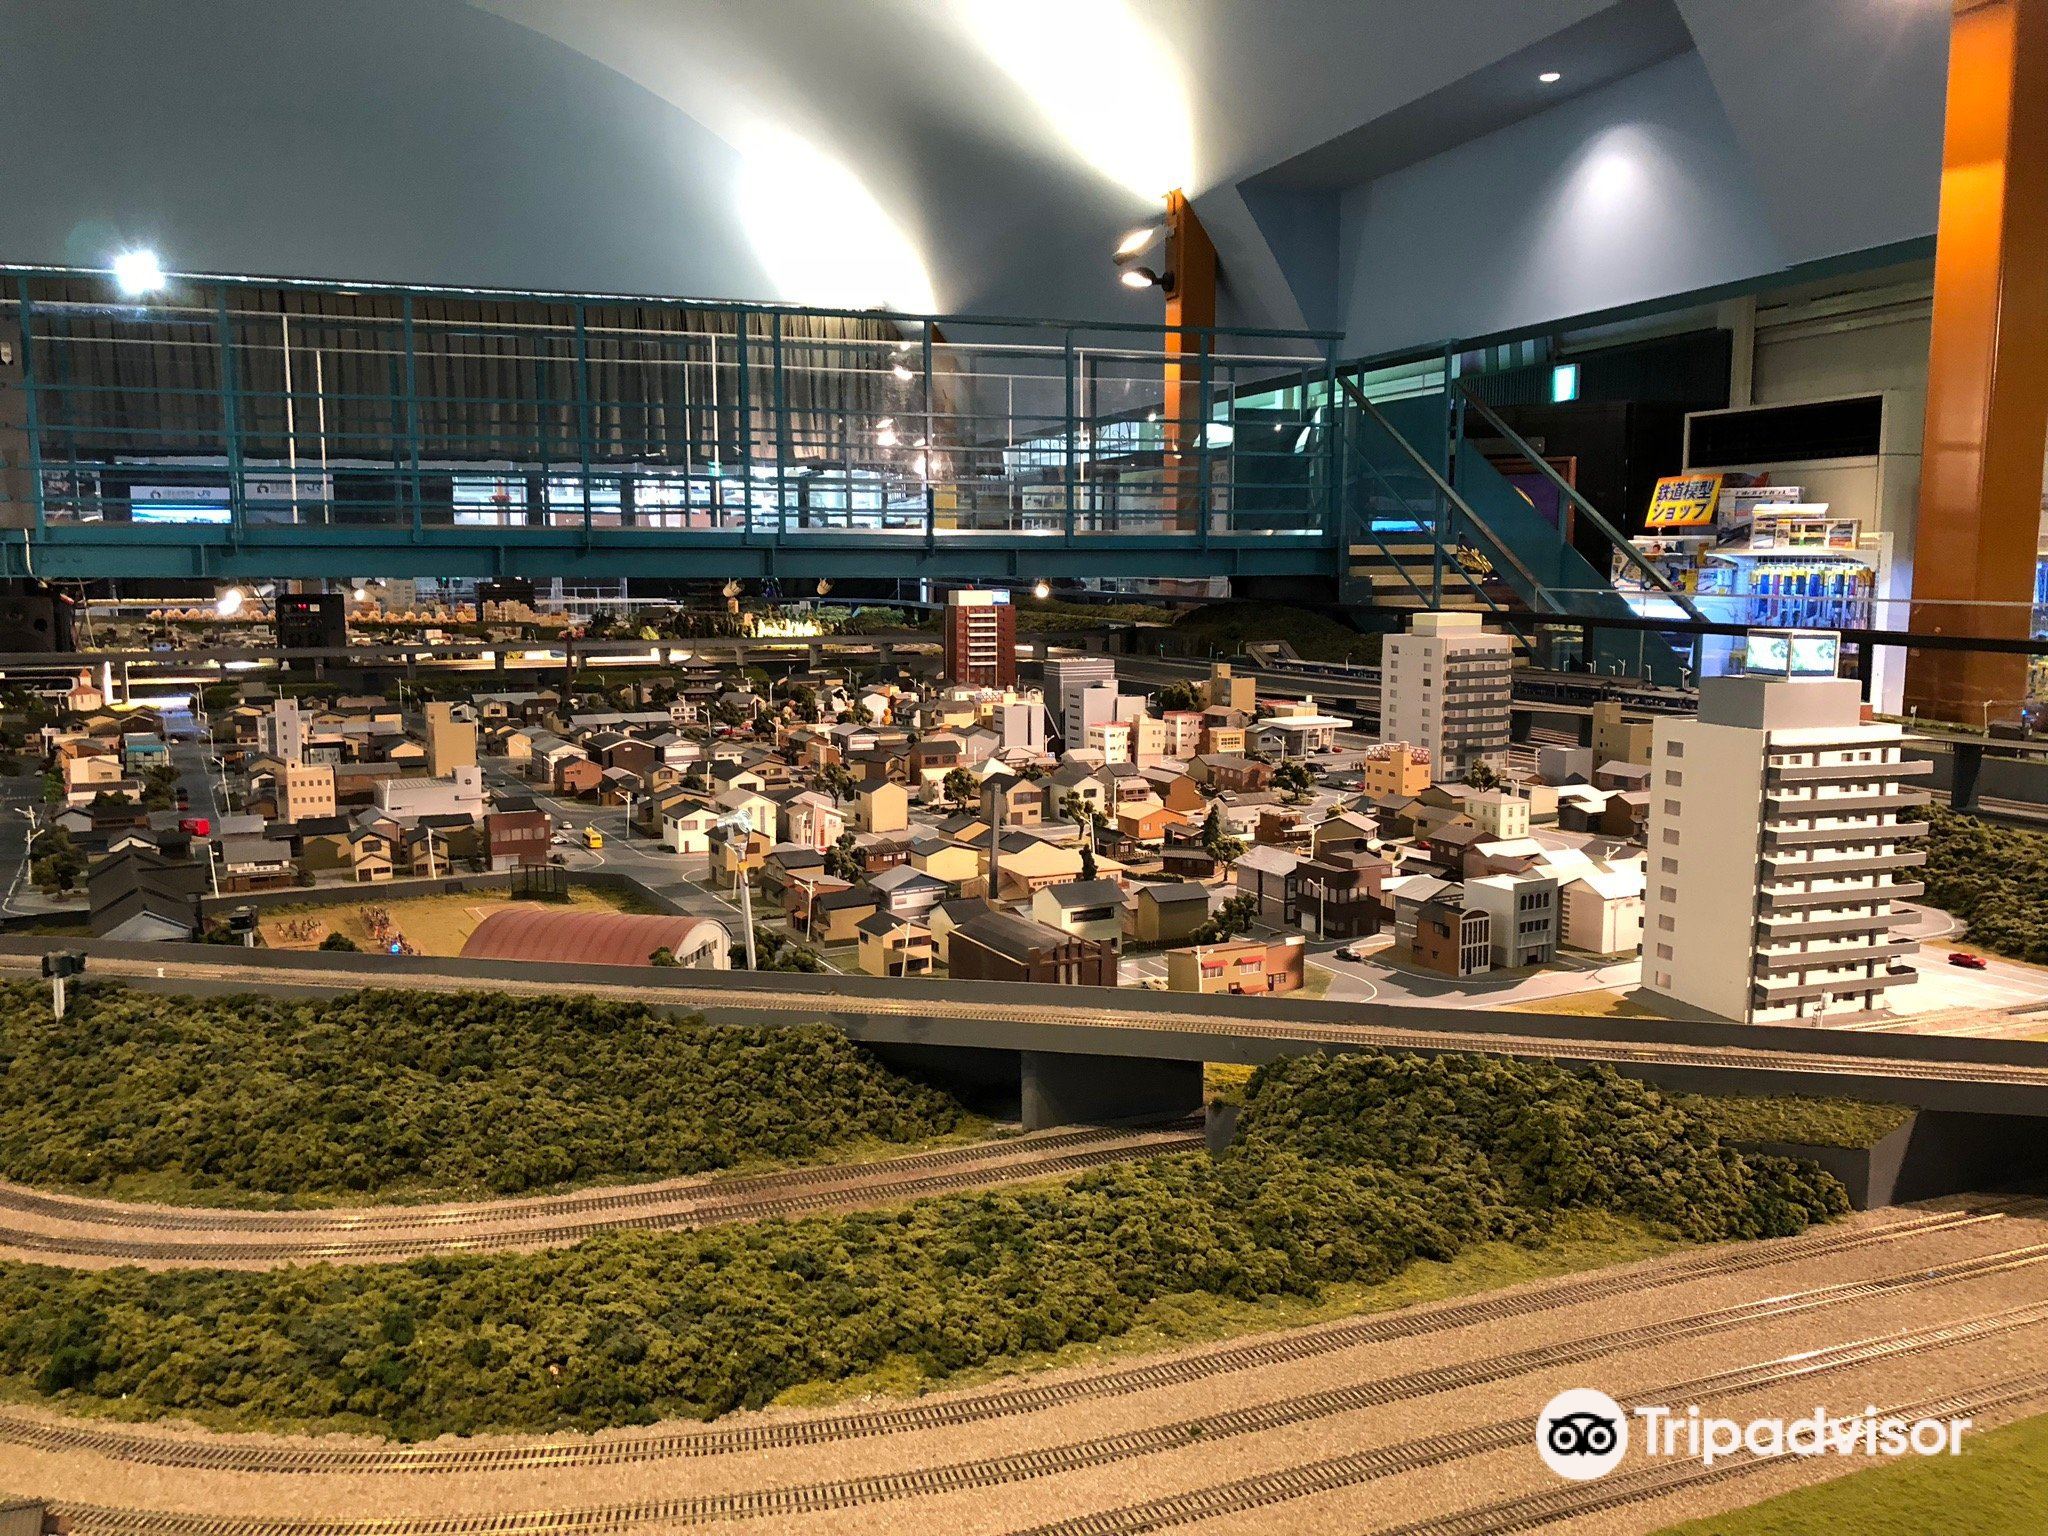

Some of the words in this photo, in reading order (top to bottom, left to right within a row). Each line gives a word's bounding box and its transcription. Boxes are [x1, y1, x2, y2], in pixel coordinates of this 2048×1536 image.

[1656, 480, 1716, 501] 鉄道模型
[1652, 503, 1709, 521] ショップ
